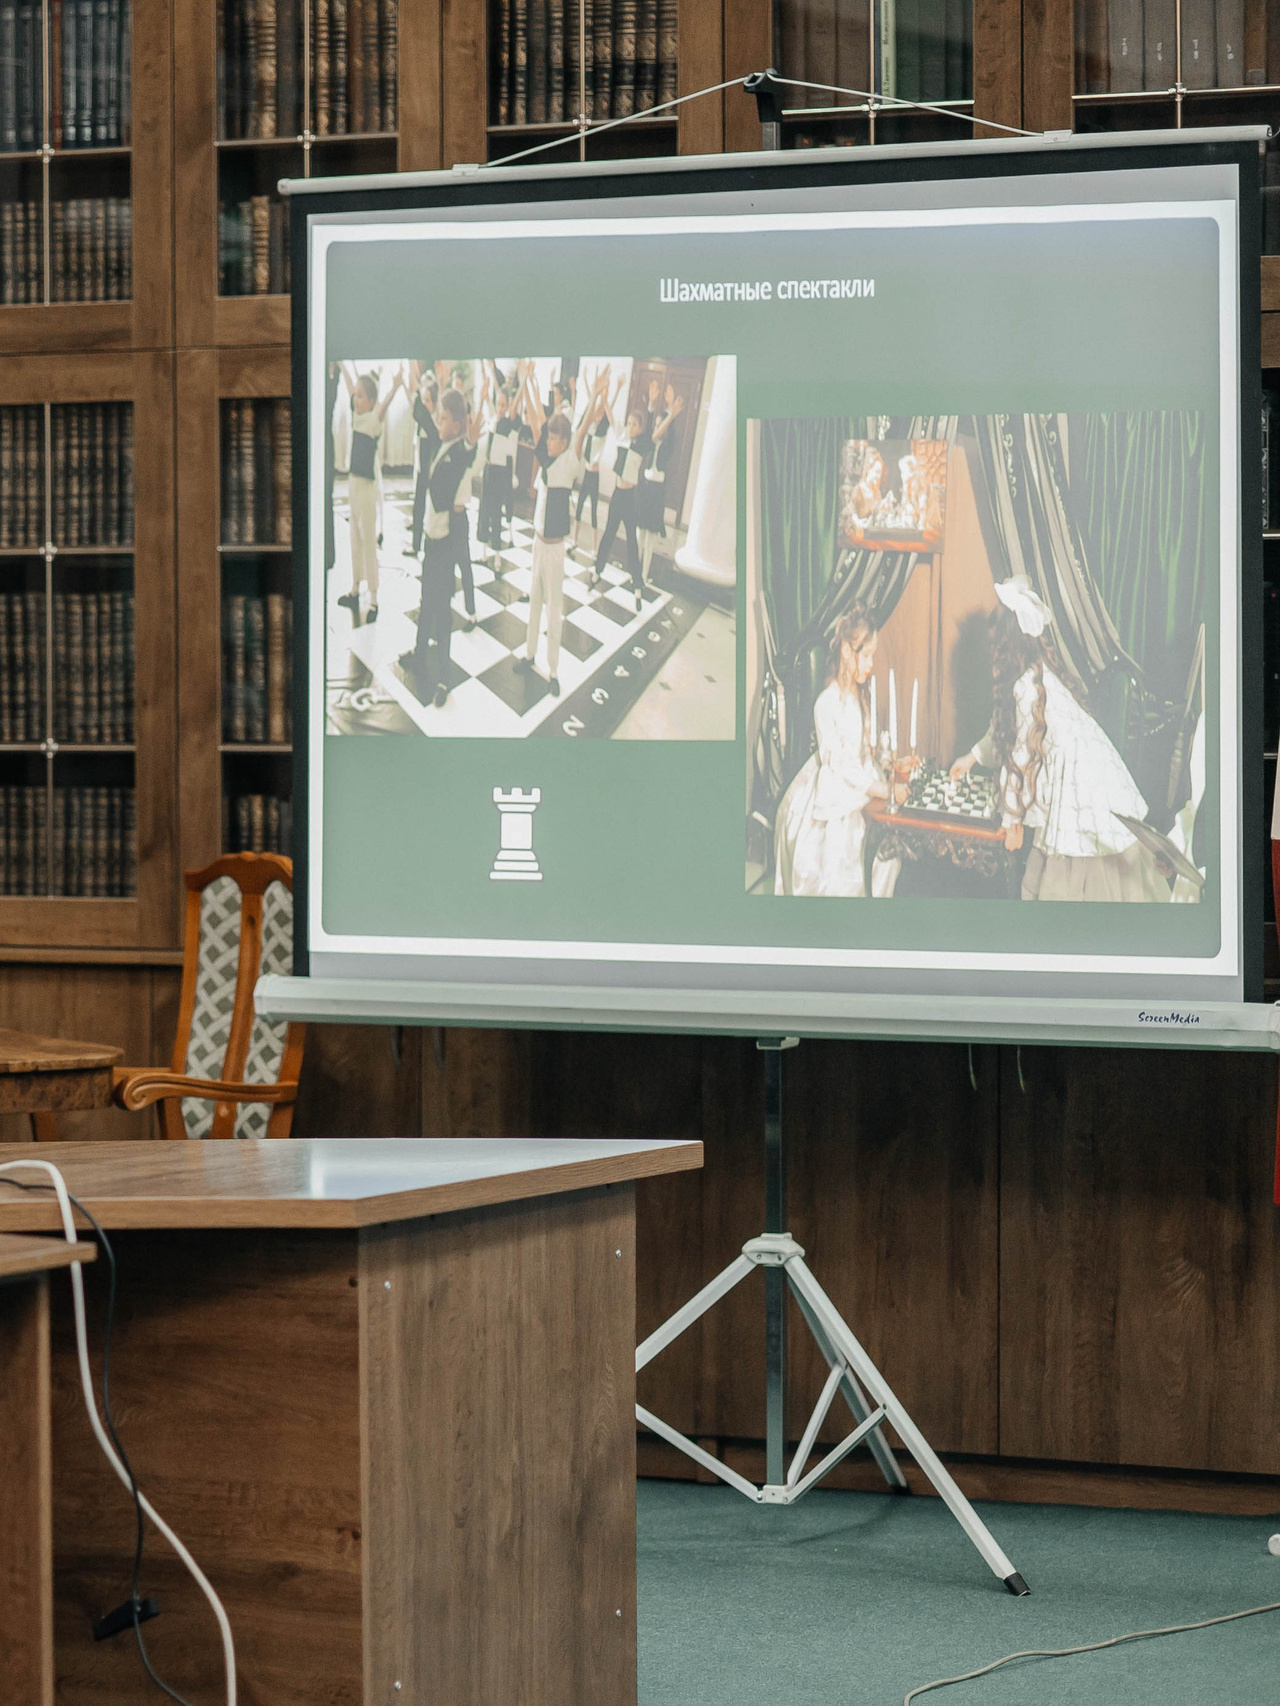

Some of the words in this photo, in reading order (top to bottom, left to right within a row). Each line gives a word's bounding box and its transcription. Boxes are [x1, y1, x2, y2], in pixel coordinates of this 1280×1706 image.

[659, 278, 772, 303] Шахматные
[777, 278, 875, 300] спектакли
[631, 646, 647, 659] 5
[614, 665, 630, 677] 4
[591, 687, 609, 705] 3
[562, 714, 585, 737] 2
[1138, 1011, 1200, 1024] ScreenMedia
